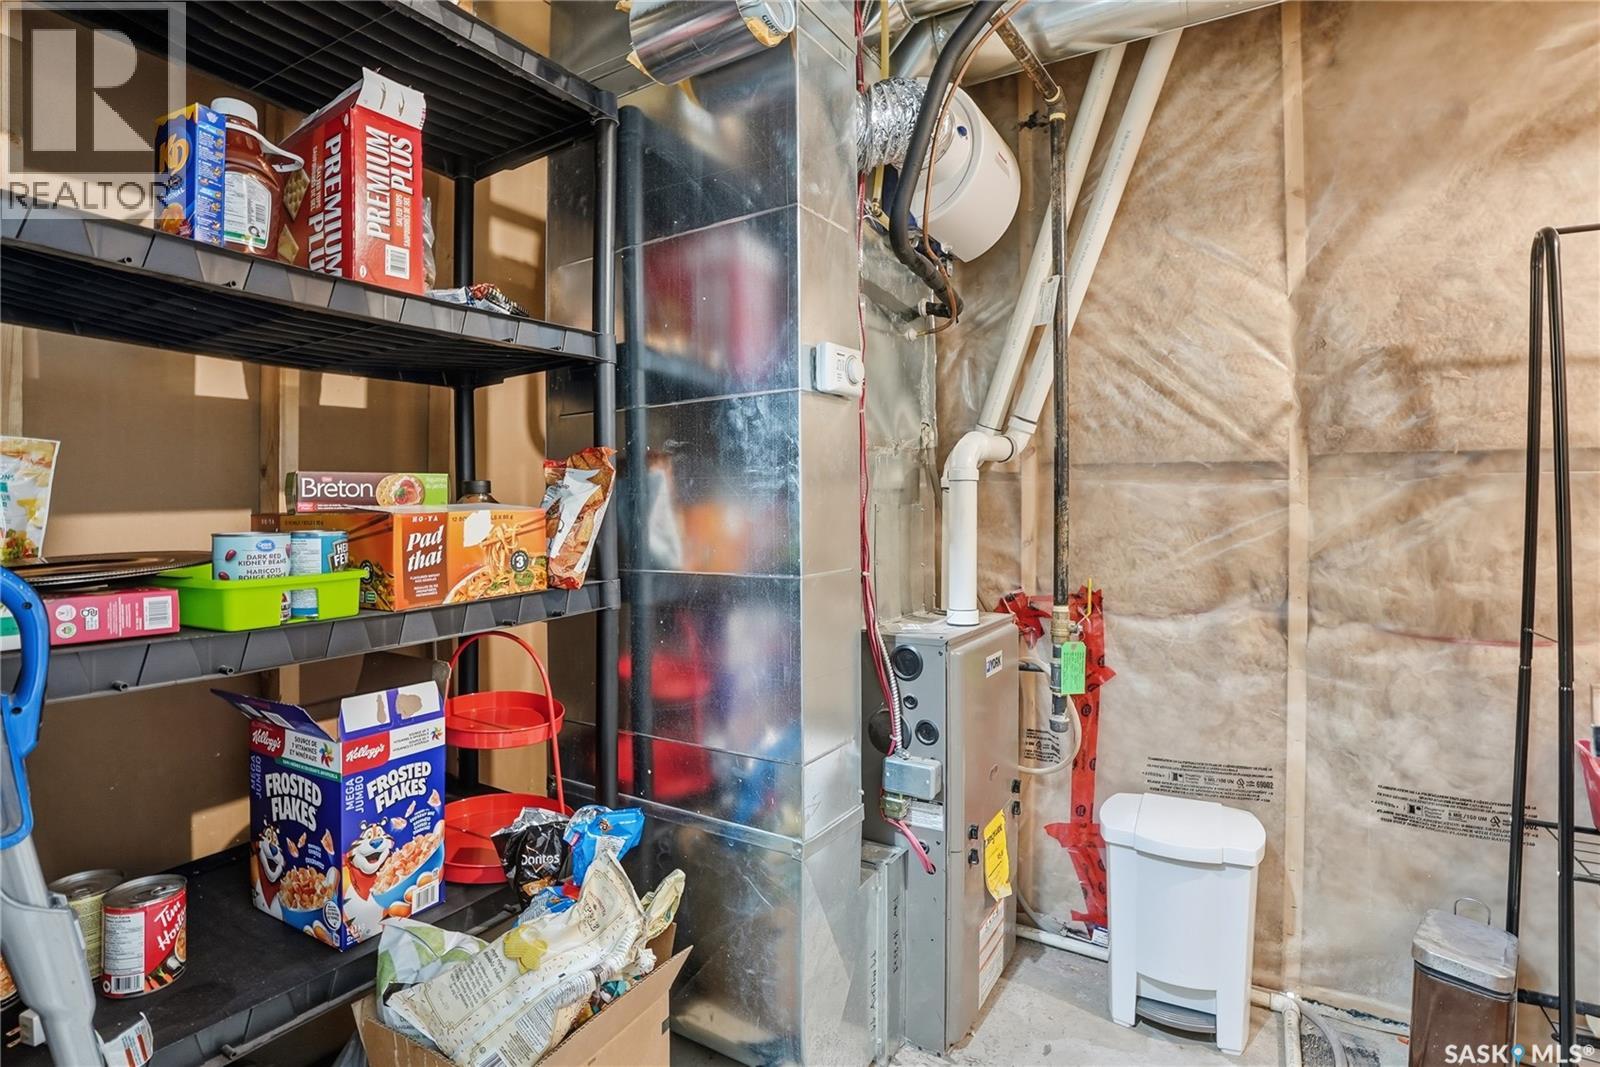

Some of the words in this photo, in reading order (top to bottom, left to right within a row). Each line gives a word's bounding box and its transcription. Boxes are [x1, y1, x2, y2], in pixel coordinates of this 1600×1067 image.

[390, 134, 414, 195] PLUS
[365, 125, 391, 241] PREMIUM
[324, 133, 343, 276] PREMIUM
[308, 211, 325, 275] PLU
[301, 477, 373, 498] Breton
[407, 524, 445, 552] Pad
[246, 567, 282, 575] HARICOTS
[407, 545, 443, 572] thai
[515, 555, 525, 568] 3
[252, 729, 281, 752] Kellogg's
[345, 744, 385, 762] Kellogg's
[265, 772, 322, 807] FROSTED
[345, 778, 354, 811] MEGA
[354, 775, 364, 813] JUMBO
[366, 761, 432, 800] FROSTED
[375, 778, 427, 814] FLAKES
[271, 796, 318, 832] FLAKES
[521, 854, 560, 866] Doritos
[153, 901, 181, 927] Tim
